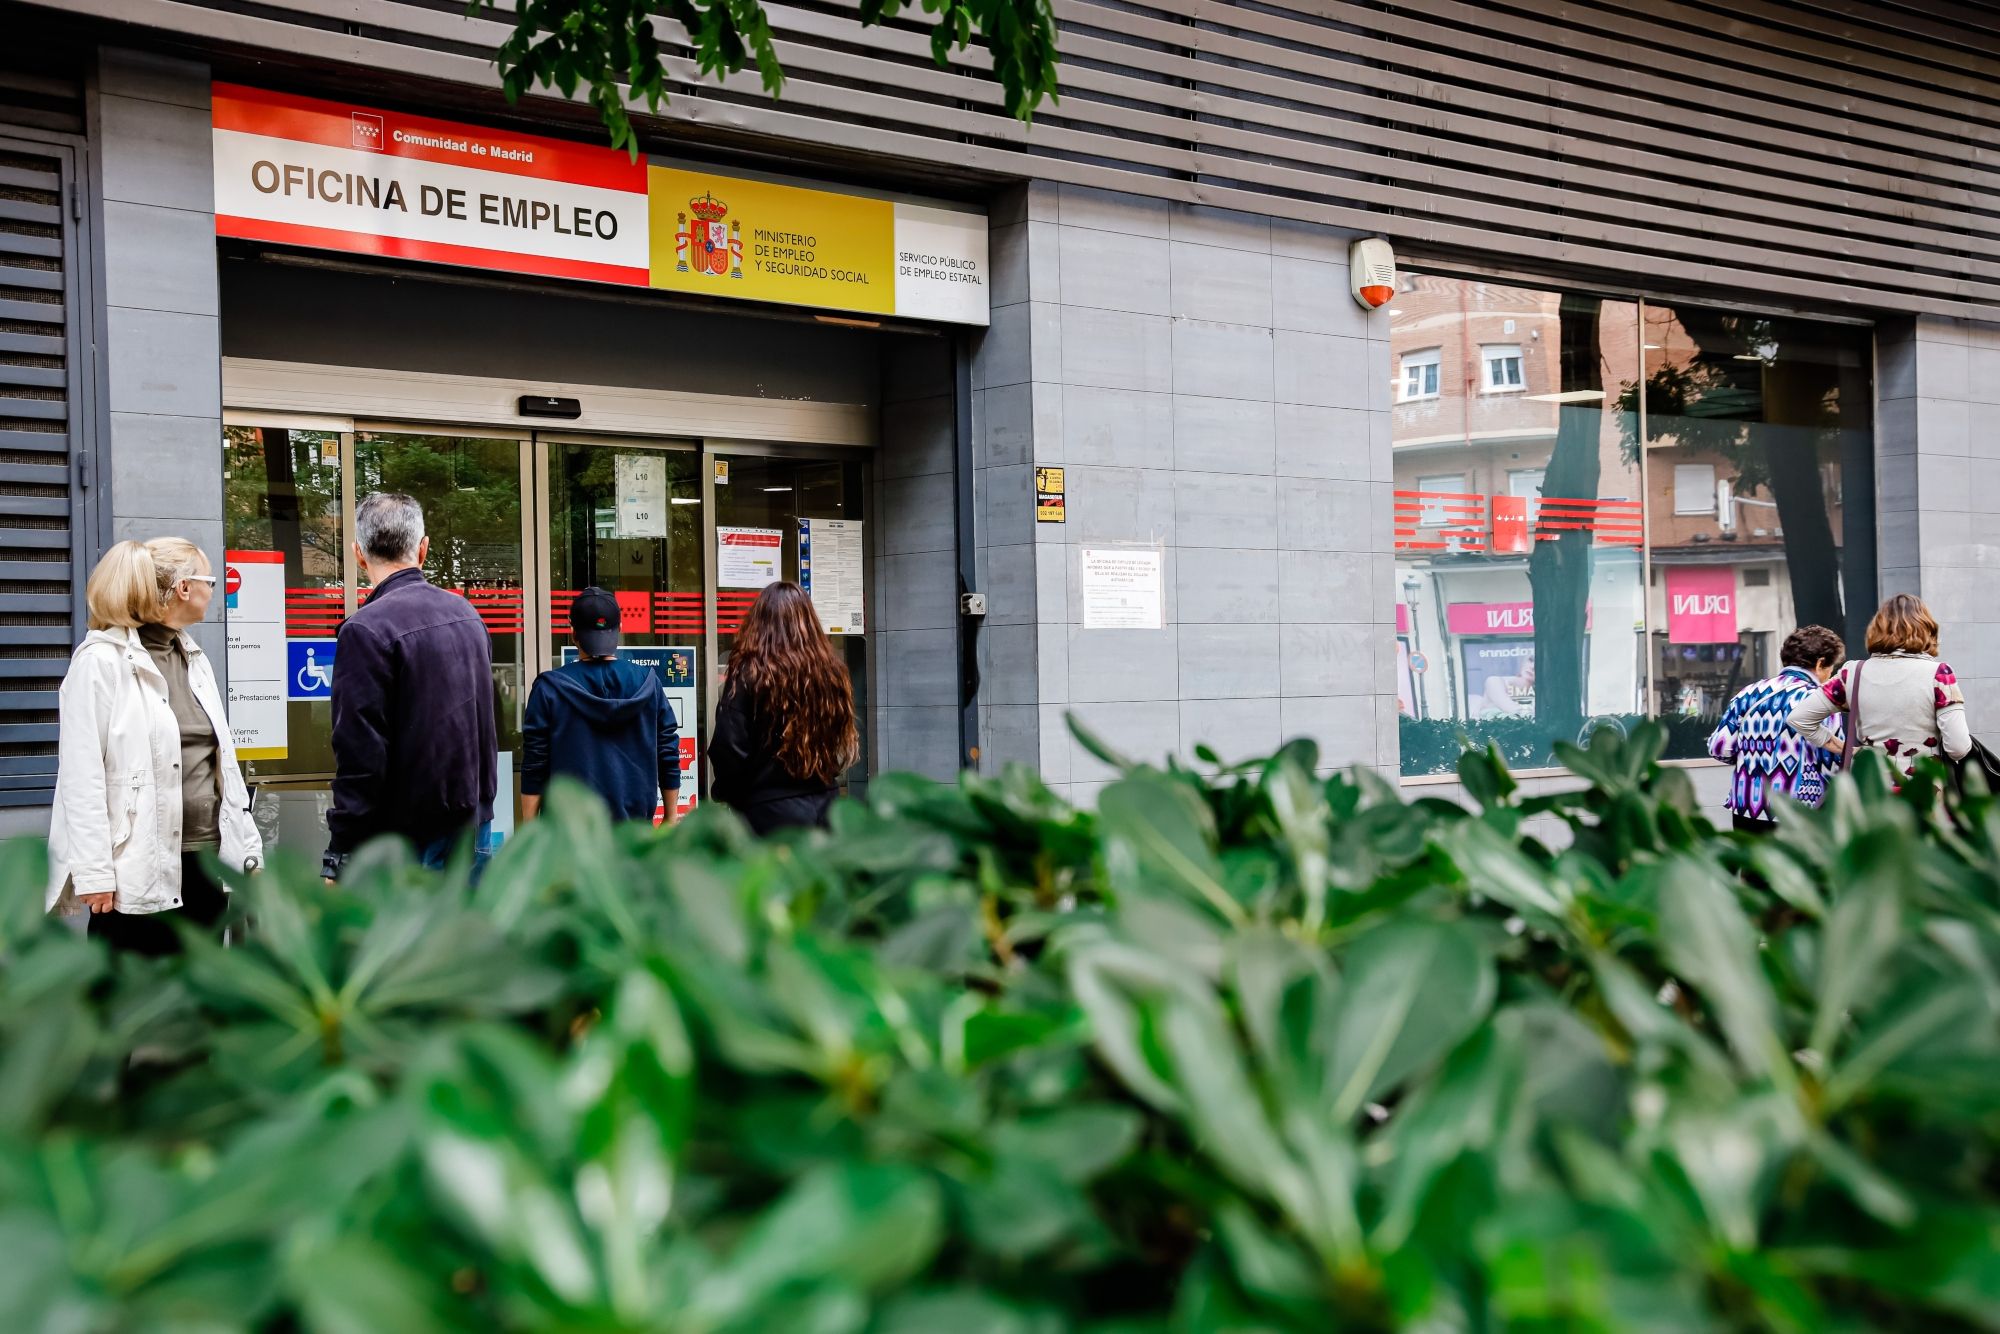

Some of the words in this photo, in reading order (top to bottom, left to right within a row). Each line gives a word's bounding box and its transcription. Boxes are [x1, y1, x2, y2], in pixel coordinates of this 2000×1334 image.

[393, 129, 468, 153] Comunidad
[470, 142, 487, 156] de
[490, 144, 533, 163] Madrid
[251, 159, 408, 213] OFICINA
[420, 184, 468, 221] DE
[479, 193, 619, 241] EMPLEO
[754, 229, 817, 248] MINISTERIO
[755, 244, 771, 258] DE
[773, 246, 815, 263] EMPLEO
[899, 251, 938, 266] SERVICIO
[939, 255, 976, 271] PÚBLICO
[755, 259, 762, 272] Y
[765, 261, 827, 280] SEGURIDAD
[830, 268, 869, 284] SOCIAL
[899, 265, 912, 277] DE
[914, 267, 947, 281] EMPLEO
[949, 272, 982, 285] ESTATAL
[636, 512, 649, 520] L10
[240, 643, 261, 651] perros
[239, 694, 280, 702] Prestaciones
